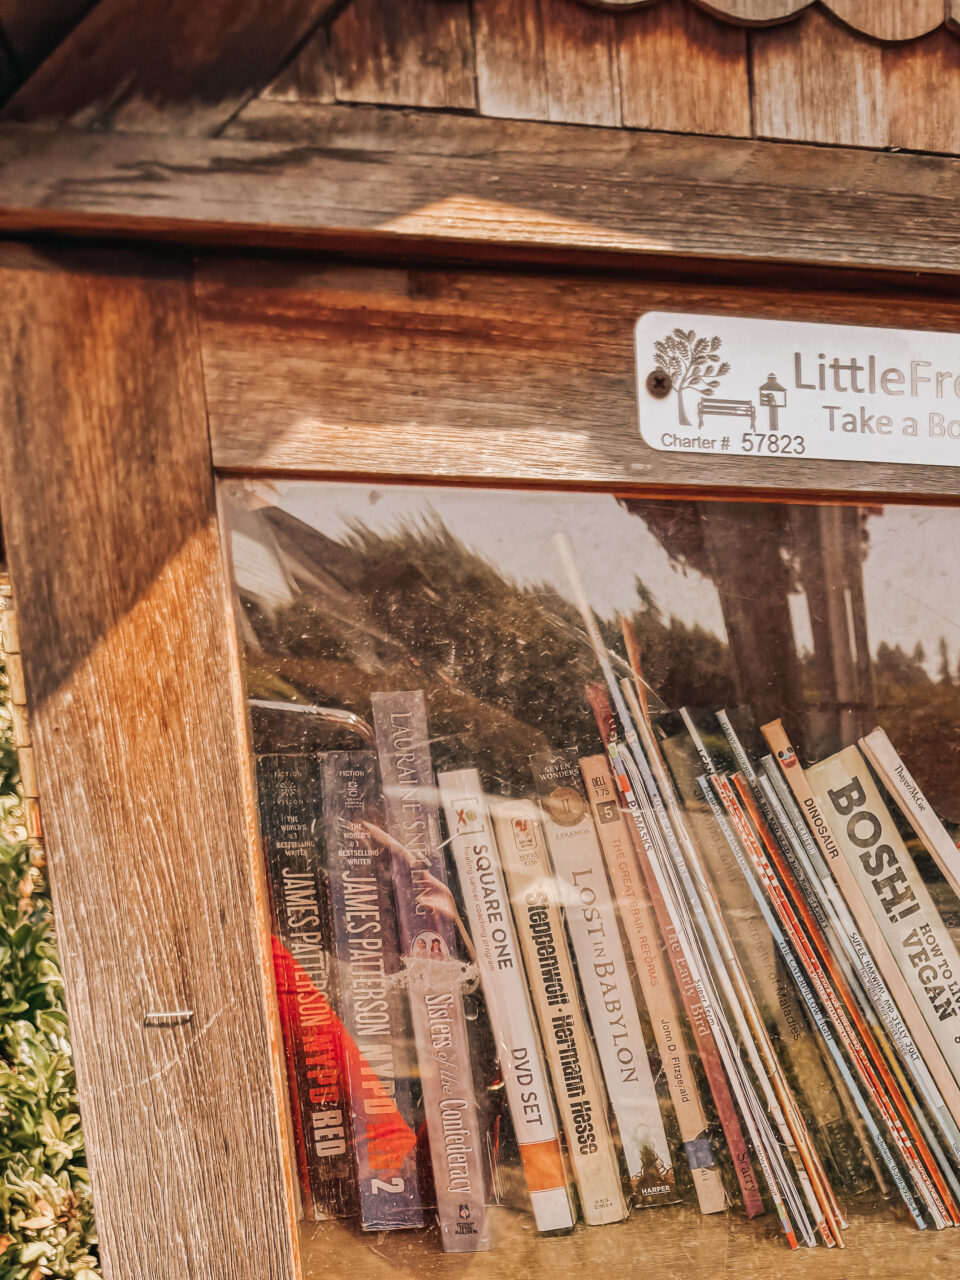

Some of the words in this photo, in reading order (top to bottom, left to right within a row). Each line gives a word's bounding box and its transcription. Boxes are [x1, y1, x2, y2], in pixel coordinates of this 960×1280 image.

[661, 432, 718, 449] Charter
[741, 433, 806, 455] 57823
[825, 405, 893, 436] Take
[902, 417, 918, 437] a
[388, 713, 424, 812] LAURAINE
[539, 769, 579, 781] WONDERS
[544, 763, 571, 773] SEVEN
[892, 764, 927, 811] Thayer/McCue
[603, 806, 614, 819] 5
[751, 784, 763, 800] THE
[630, 814, 656, 852] MASKS
[792, 820, 817, 854] CLANTON
[797, 797, 845, 858] DINOSAUR
[826, 779, 922, 921] BOSH!
[460, 846, 476, 877] healing
[278, 864, 322, 929] JAMES
[339, 868, 381, 934] JAMES
[471, 844, 503, 922] SQUARE
[490, 927, 513, 970] ONE
[611, 837, 625, 859] THE
[618, 861, 636, 898] GREAT
[638, 936, 659, 986] REFORMS
[284, 930, 334, 1027] PATTERSON
[572, 868, 608, 939] LOST
[593, 961, 642, 1082] BABYLON
[895, 930, 960, 1022] VEGAN
[917, 922, 945, 959] HOW
[936, 958, 955, 980] TO
[345, 937, 393, 1036] PATTERSON
[671, 956, 697, 1001] Early
[688, 1002, 710, 1036] Bird
[692, 978, 710, 1003] Super
[774, 987, 802, 1040] Maladies
[787, 959, 821, 1015] CATERPILLOW
[848, 932, 867, 958] SUPER
[862, 960, 888, 997] NARWHAL
[890, 1015, 908, 1039] JELLY
[903, 1040, 920, 1063] JOLT
[424, 992, 460, 1049] Sisters
[523, 892, 569, 1005] Steppenwolf
[551, 1015, 589, 1096] Hermann
[570, 1100, 600, 1155] Hesse
[299, 1033, 342, 1106] NYPD
[356, 1043, 398, 1115] NYPD
[509, 1046, 534, 1087] DVD
[660, 1018, 674, 1042] John
[668, 1057, 690, 1102] Fitzgerald
[309, 1109, 348, 1157] RED
[519, 1090, 542, 1128] SET
[433, 1097, 483, 1195] Confederacy
[733, 1151, 758, 1193] Scarry
[371, 1175, 404, 1196] 2
[641, 1184, 671, 1196] HARPER
